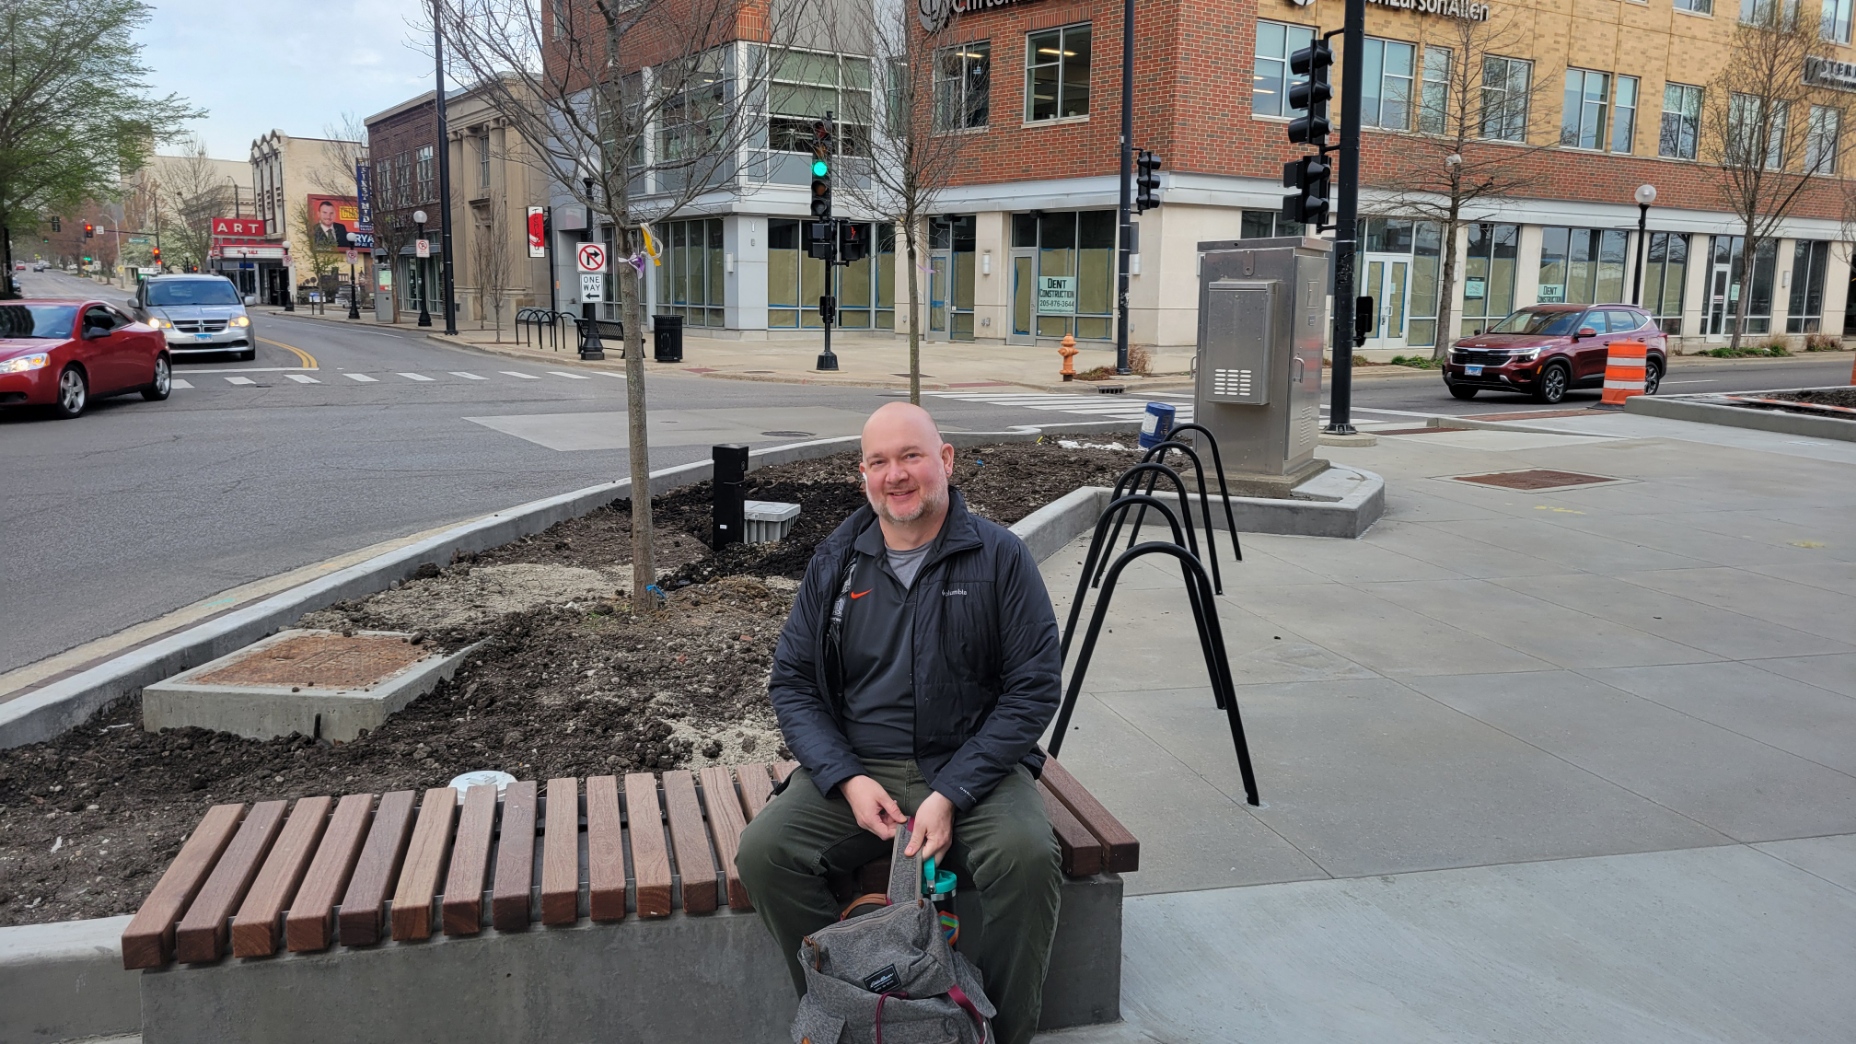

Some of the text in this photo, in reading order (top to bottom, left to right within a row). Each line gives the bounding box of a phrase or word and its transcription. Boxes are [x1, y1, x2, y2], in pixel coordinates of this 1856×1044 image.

[1367, 0, 1490, 21] arsonAllen
[1820, 60, 1856, 78] STER
[217, 222, 259, 234] ART
[583, 276, 600, 284] ONE
[1047, 278, 1067, 289] DENT
[1543, 285, 1558, 295] DENT
[942, 588, 967, 597] olumbia
